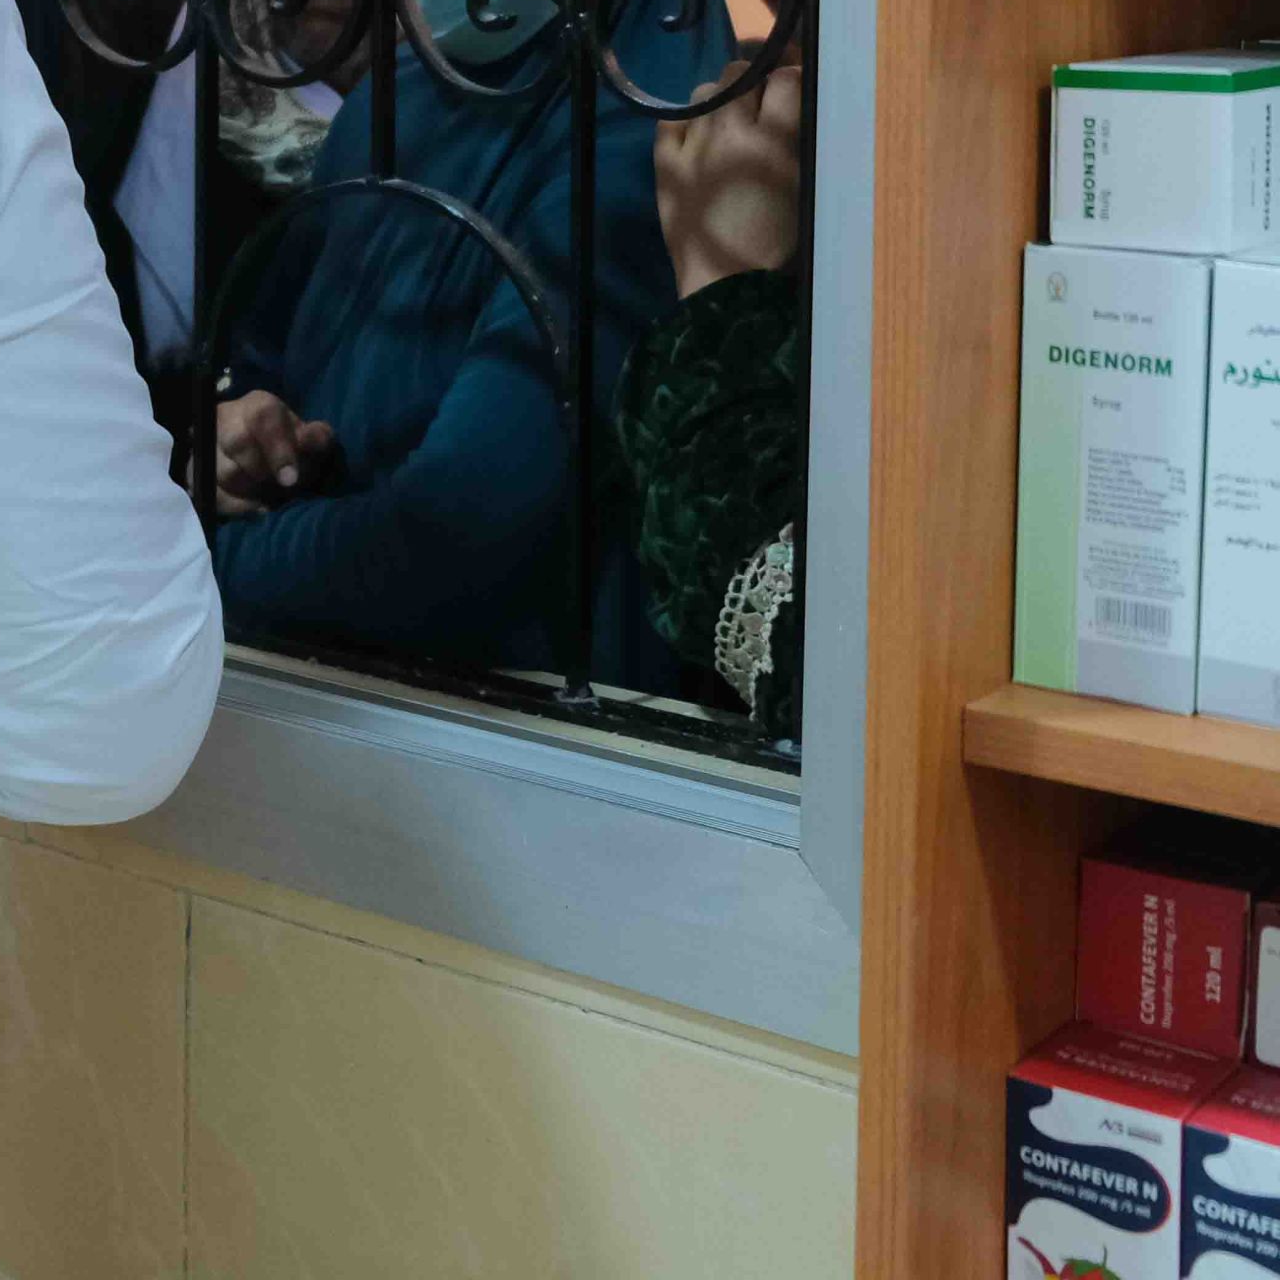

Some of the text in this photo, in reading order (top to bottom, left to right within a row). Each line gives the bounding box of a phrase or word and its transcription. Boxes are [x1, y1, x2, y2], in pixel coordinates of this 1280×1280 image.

[1083, 117, 1096, 220] DIGENORM
[1048, 345, 1173, 378] DIGENORM
[1140, 894, 1159, 1024] CONTAFEVER N
[1020, 1145, 1158, 1202] CONTAFEVER N
